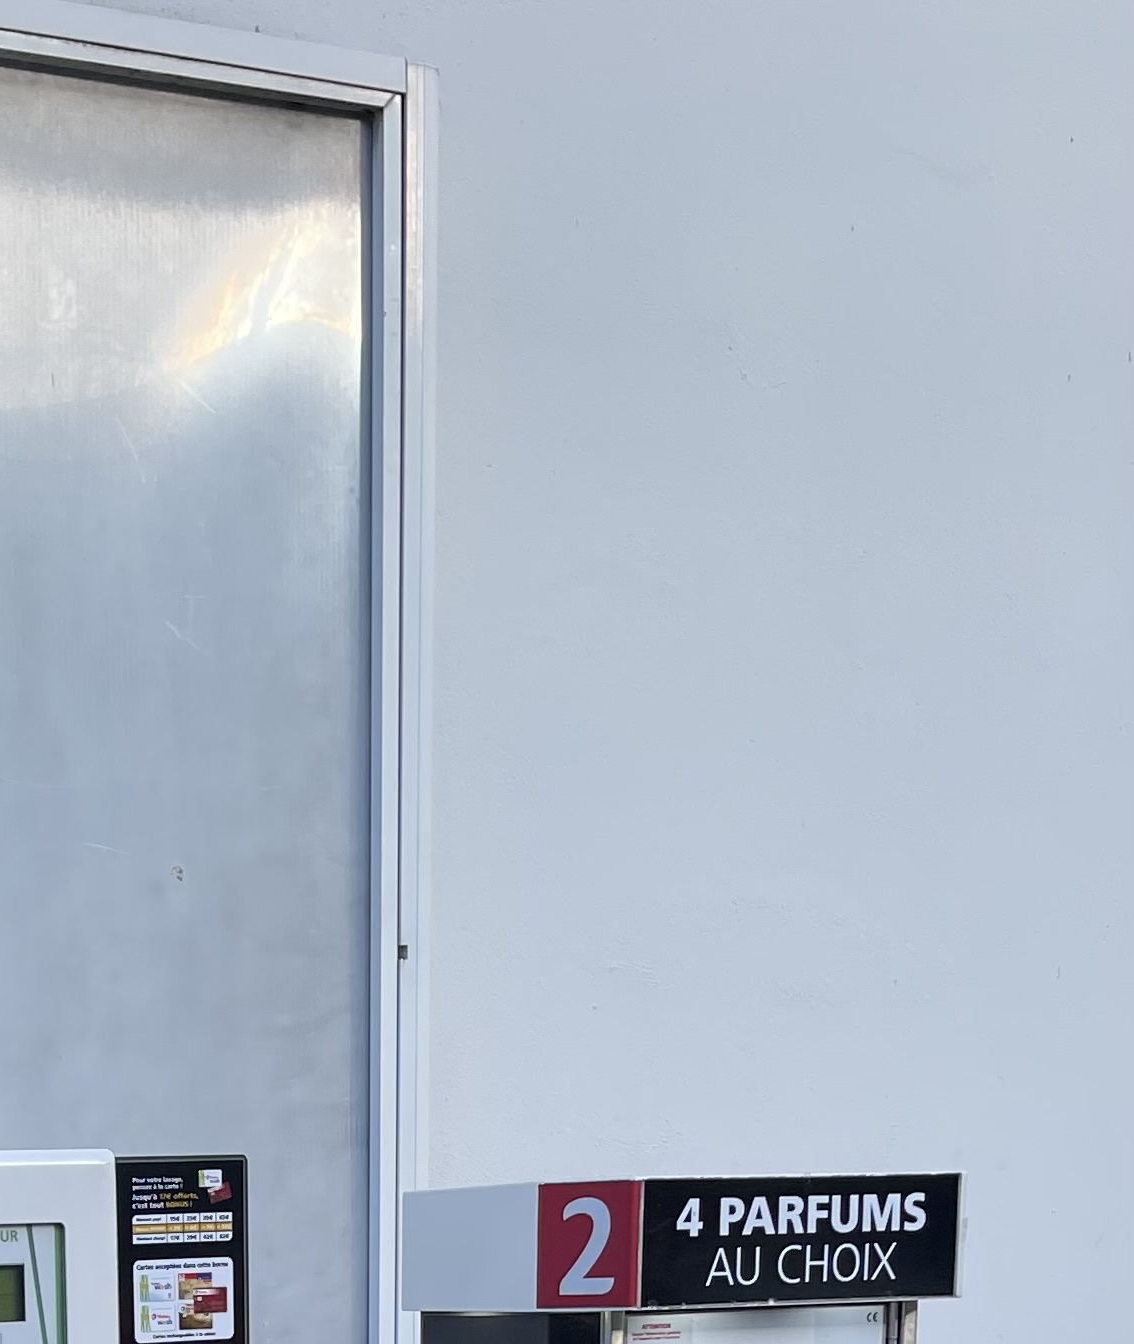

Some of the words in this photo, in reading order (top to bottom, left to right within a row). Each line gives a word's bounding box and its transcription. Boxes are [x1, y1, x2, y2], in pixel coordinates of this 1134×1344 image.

[676, 1197, 703, 1236] 4
[719, 1191, 925, 1236] PARFUMS
[559, 1197, 614, 1295] 2
[705, 1246, 760, 1286] AU
[778, 1241, 896, 1283] CHOIX
